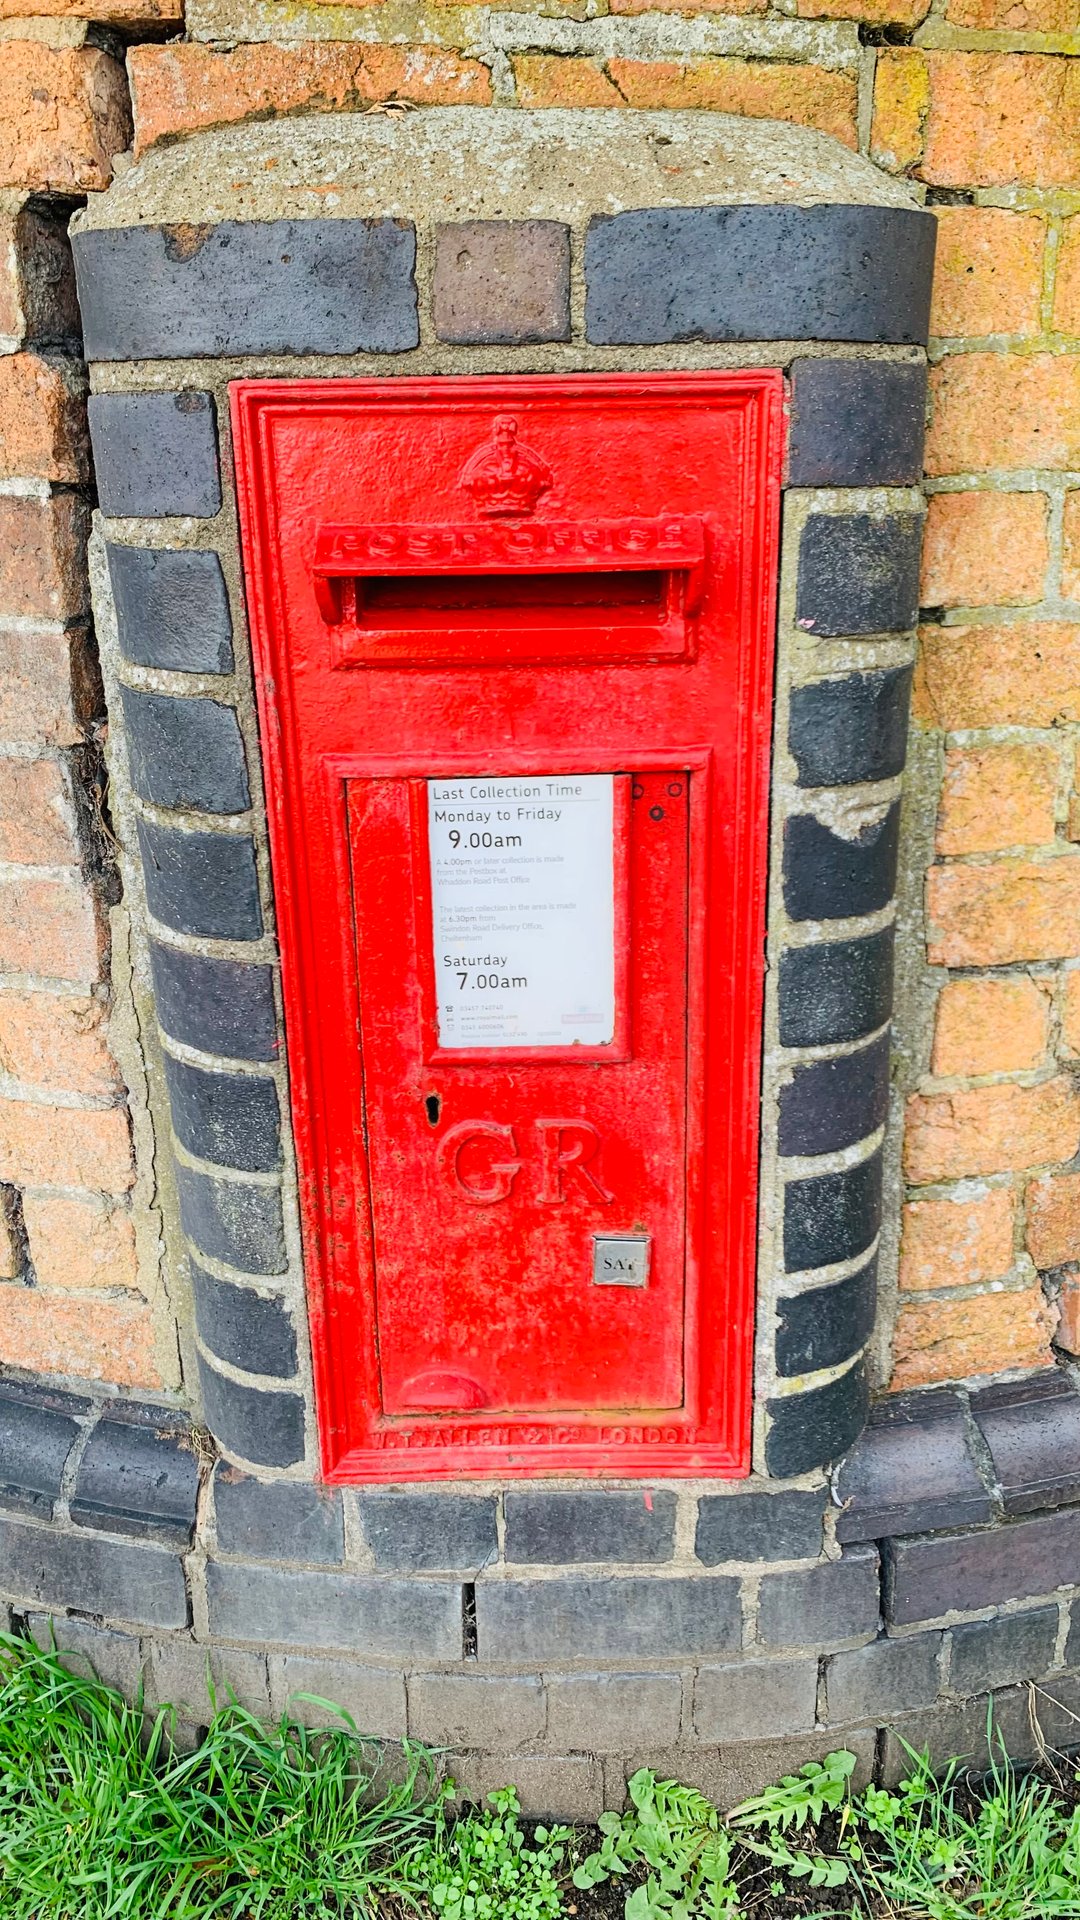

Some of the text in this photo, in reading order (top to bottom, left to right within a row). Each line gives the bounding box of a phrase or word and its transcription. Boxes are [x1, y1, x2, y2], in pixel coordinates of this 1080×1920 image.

[329, 524, 687, 559] POST OFFICE
[433, 783, 583, 801] Last Collection Time
[434, 808, 562, 824] Monday to Friday
[448, 829, 522, 849] 9.00am
[443, 857, 472, 867] 4.00pm
[483, 857, 500, 865] later
[501, 856, 535, 864] collection
[544, 855, 565, 863] made
[456, 868, 468, 876] the
[473, 877, 492, 885] Road
[493, 876, 509, 884] Post
[510, 875, 531, 883] Office
[440, 905, 453, 914] The
[454, 905, 474, 913] latest
[475, 904, 509, 912] collection
[518, 903, 530, 911] the
[556, 902, 577, 910] made
[448, 915, 477, 924] 6.30pm
[440, 925, 471, 933] Swindon
[472, 924, 491, 932] Road
[492, 923, 521, 932] Delivery
[443, 954, 508, 968] Saturday
[456, 972, 528, 990] 7.00am
[436, 1118, 616, 1206] GR
[432, 1427, 513, 1446] ALLEN
[599, 1426, 699, 1446] LONDON
